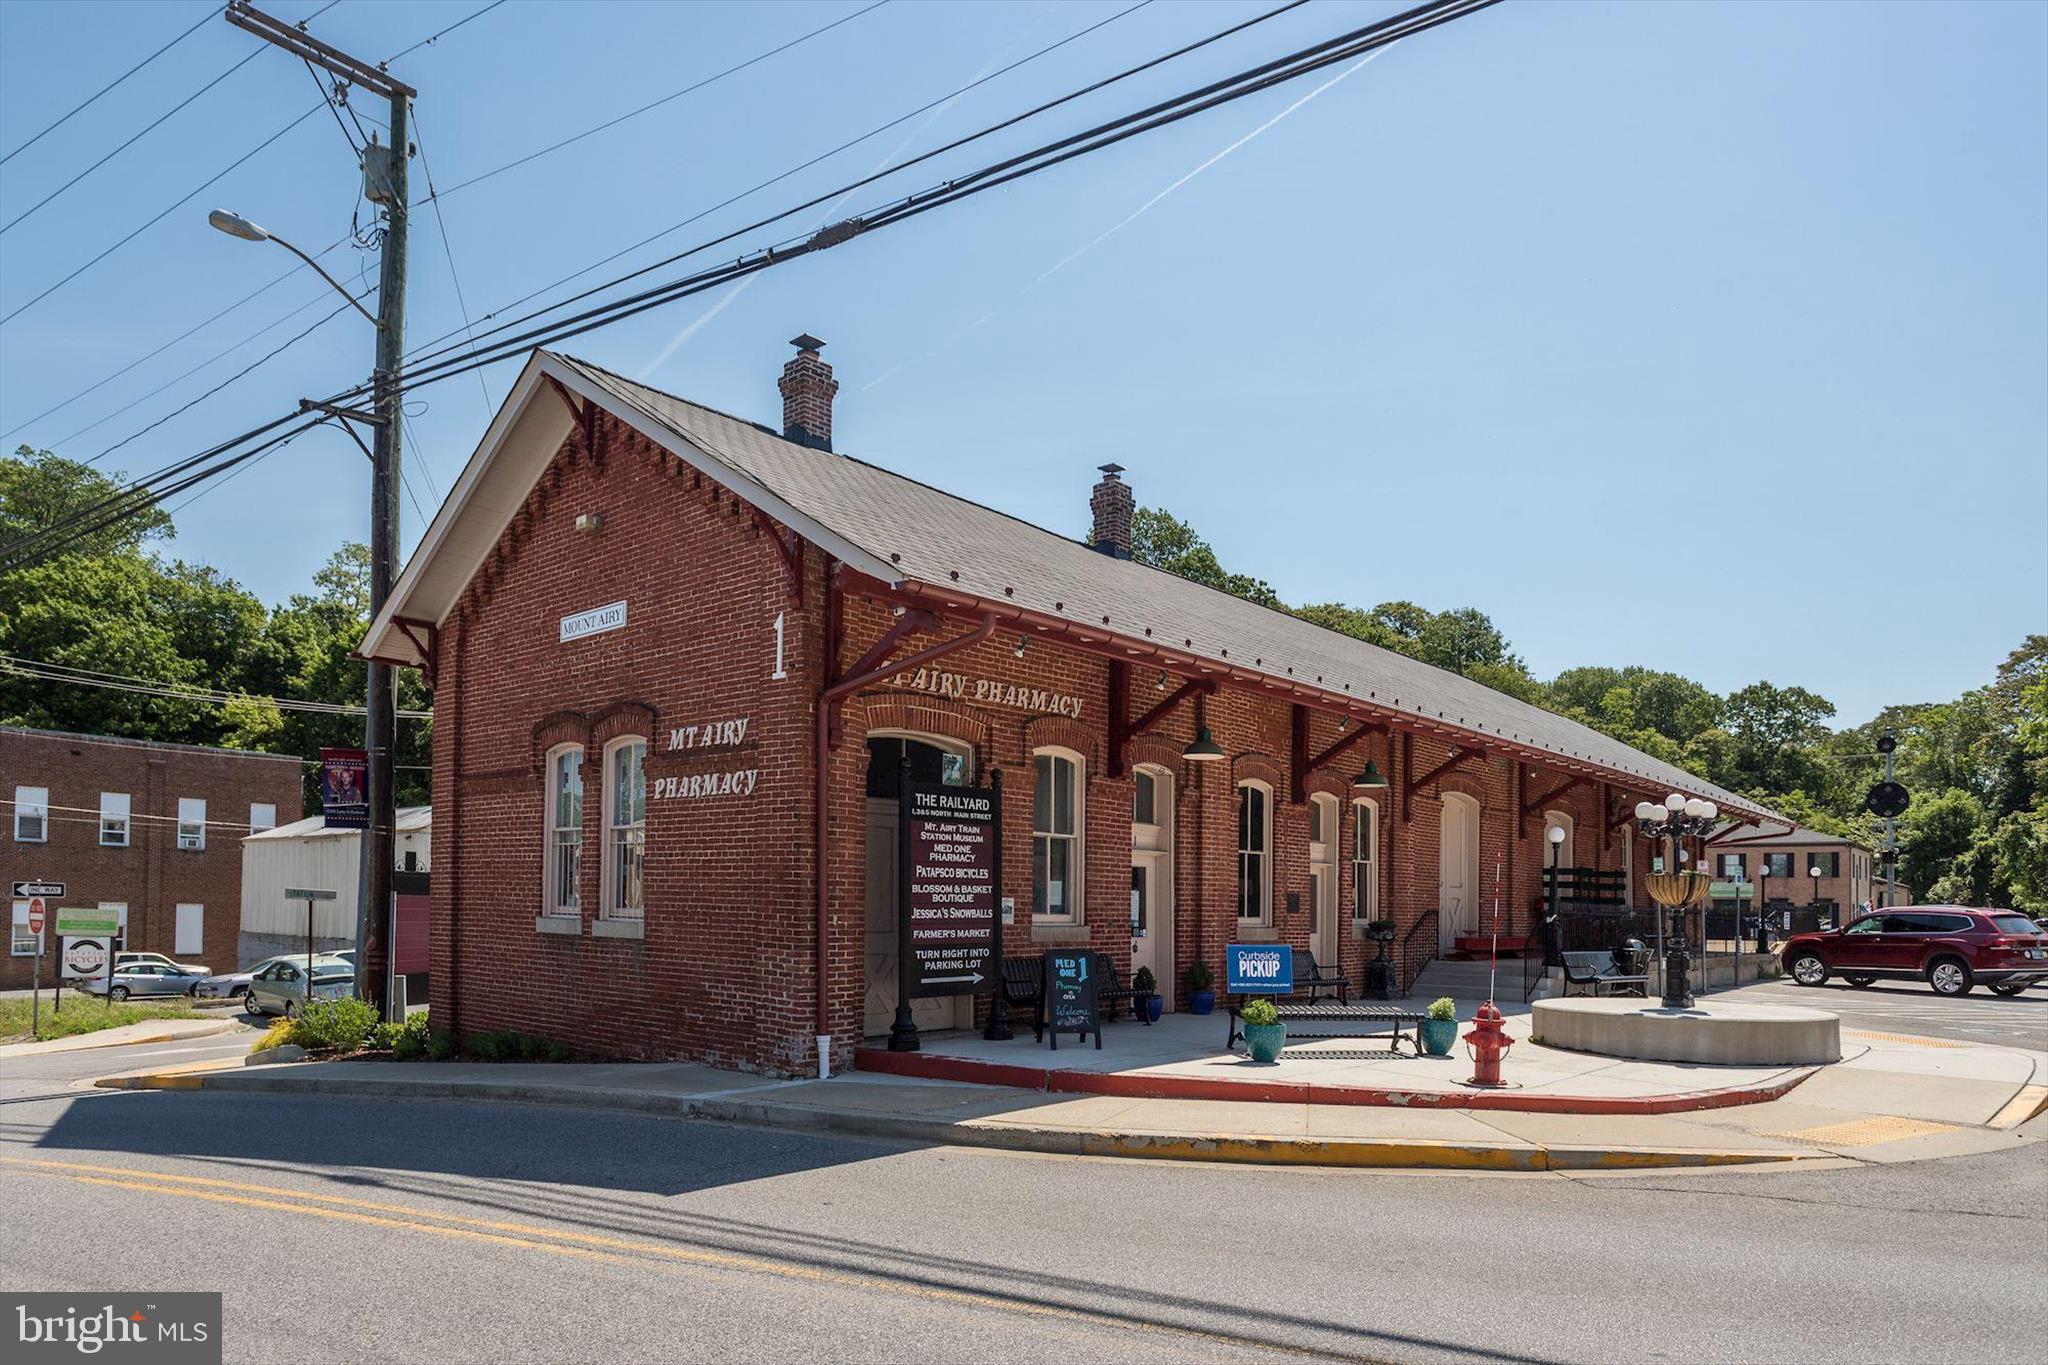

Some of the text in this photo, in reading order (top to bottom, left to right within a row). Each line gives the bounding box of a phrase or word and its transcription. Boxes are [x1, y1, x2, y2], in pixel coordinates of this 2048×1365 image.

[563, 607, 622, 636] MOUNT AIRY
[772, 611, 787, 680] 1
[910, 667, 967, 698] AIRY
[974, 679, 1084, 719] PHARMACY
[668, 718, 749, 751] MT AIRY
[653, 769, 758, 800] PHARMACY
[916, 793, 990, 811] THE RAILYARD
[940, 824, 957, 833] AIRY
[958, 825, 980, 833] TRAIN
[921, 832, 984, 843] STATION MUSEUM
[934, 844, 972, 853] MED ONE
[930, 853, 976, 863] PHARMACY
[956, 868, 989, 879] BICYCLES
[912, 884, 993, 894] BLOSSOM & BASKET
[932, 894, 974, 903] BOUTIQUE
[950, 907, 993, 918] SNOWBALLS
[913, 929, 990, 938] FARMER'S MARKET
[915, 948, 990, 959] TURN RIGHT INTO
[1238, 951, 1280, 960] Curbside
[924, 960, 981, 970] PARKING LOT
[1055, 959, 1075, 968] MED
[1239, 960, 1280, 978] PICKUP
[1060, 969, 1076, 977] ONE
